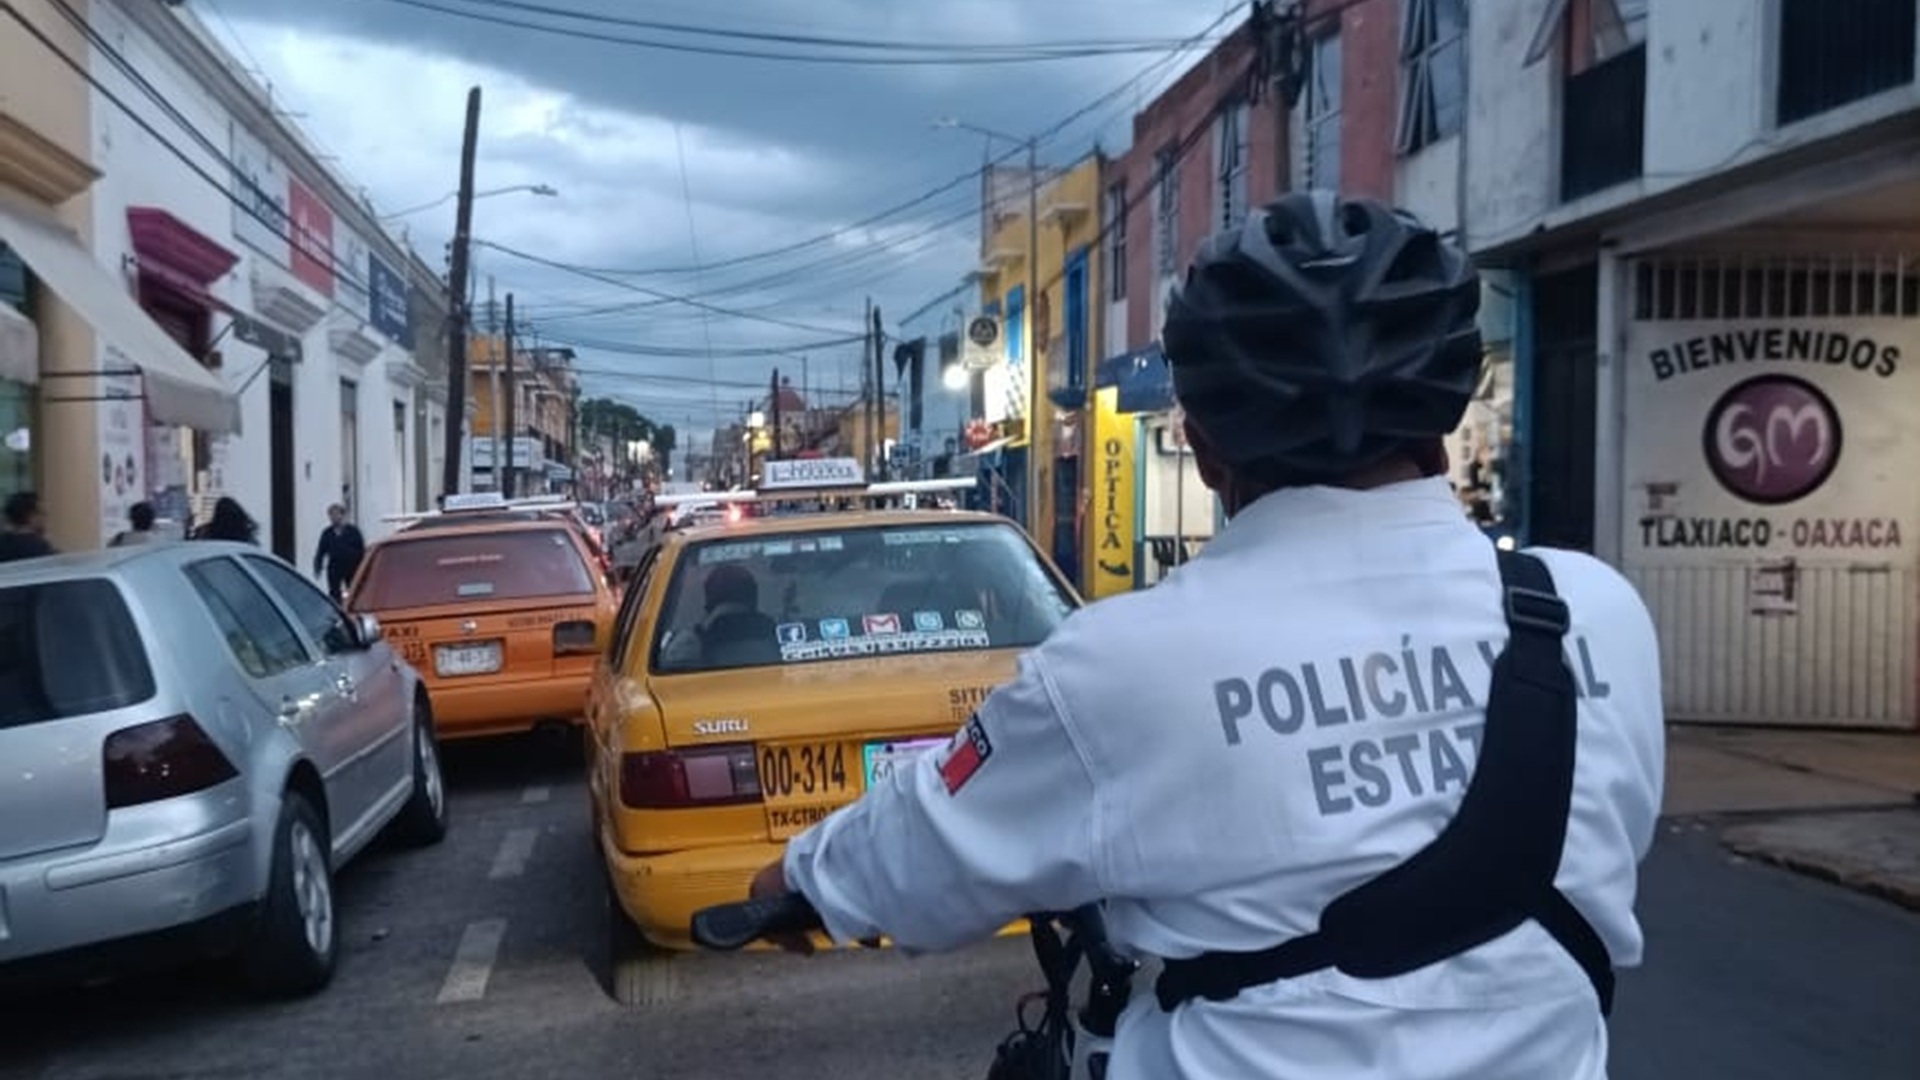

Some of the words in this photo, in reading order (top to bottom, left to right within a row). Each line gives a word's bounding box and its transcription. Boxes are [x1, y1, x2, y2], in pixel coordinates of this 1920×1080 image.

[1650, 328, 1900, 381] BIENVENIDOS
[1102, 438, 1121, 549] OPTICA
[1640, 518, 1771, 547] TLAXIACO
[1792, 518, 1902, 547] OAXACA
[1215, 634, 1475, 746] POLICÍA
[1477, 636, 1610, 699] VL
[761, 743, 846, 797] 00-314
[1307, 722, 1485, 815] ESTAT
